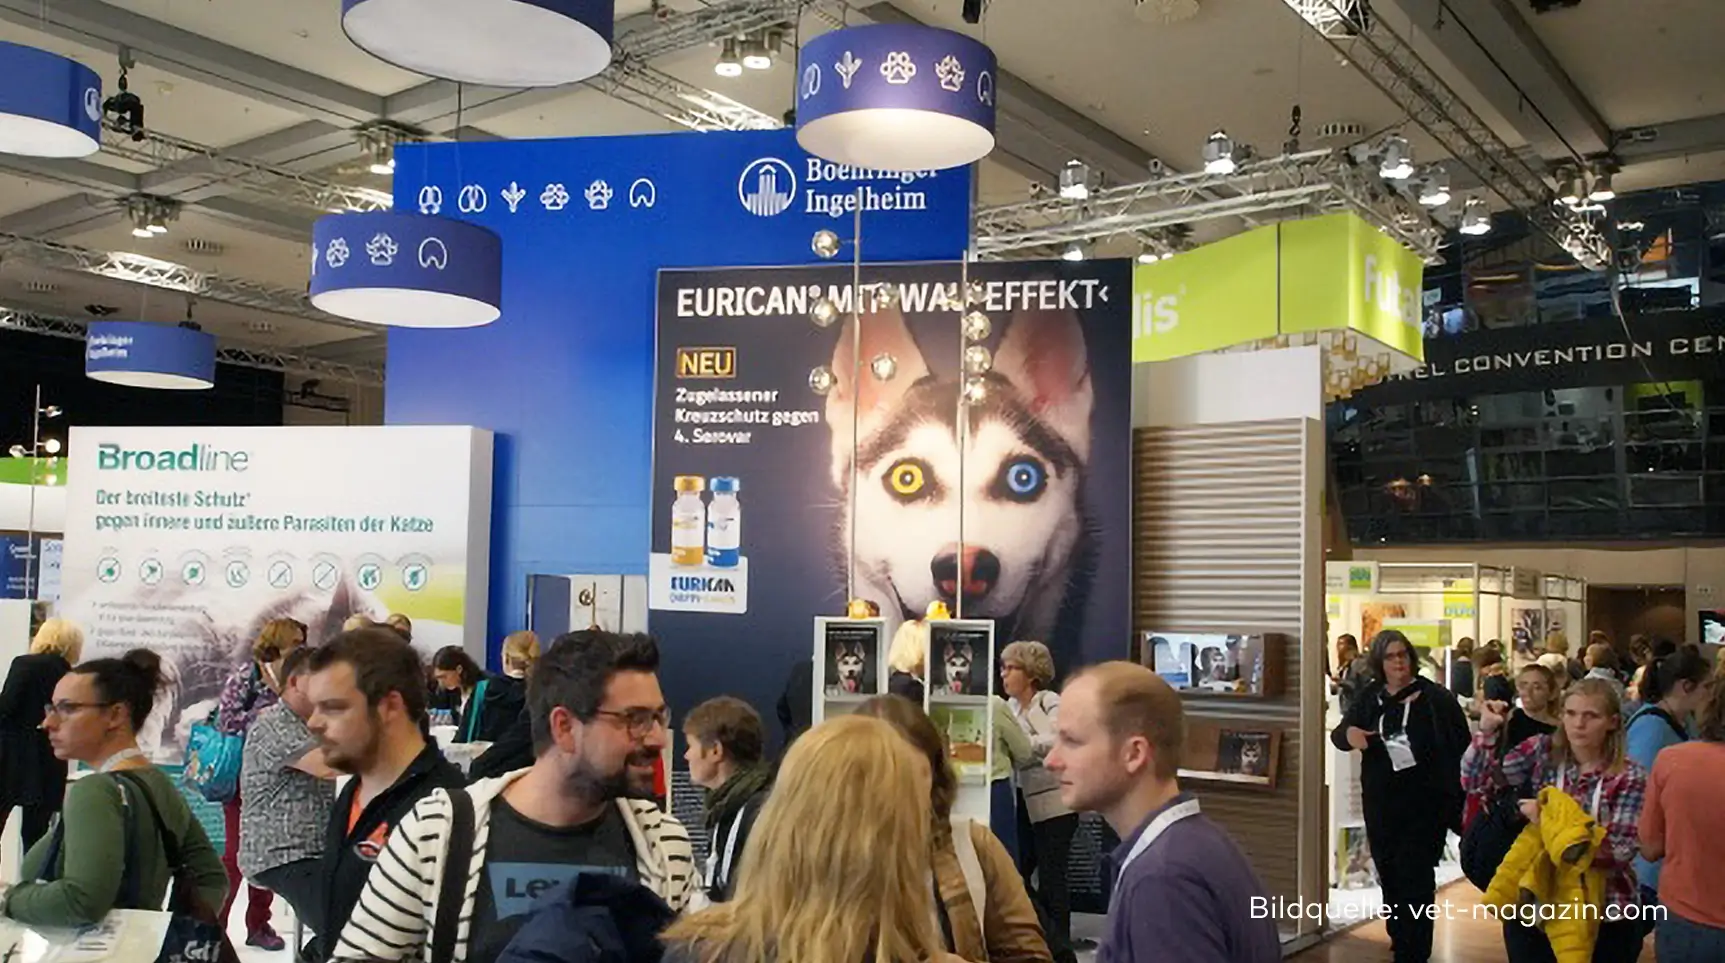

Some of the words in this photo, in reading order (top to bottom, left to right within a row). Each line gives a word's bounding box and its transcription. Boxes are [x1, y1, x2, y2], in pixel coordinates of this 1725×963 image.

[805, 185, 926, 217] Ingelheim
[680, 352, 732, 375] NEU
[1455, 342, 1652, 374] CONVENTION
[99, 443, 249, 472] Broadline
[97, 489, 121, 505] Der
[194, 514, 223, 530] und
[284, 515, 355, 532] Parasiten
[360, 516, 384, 532] der
